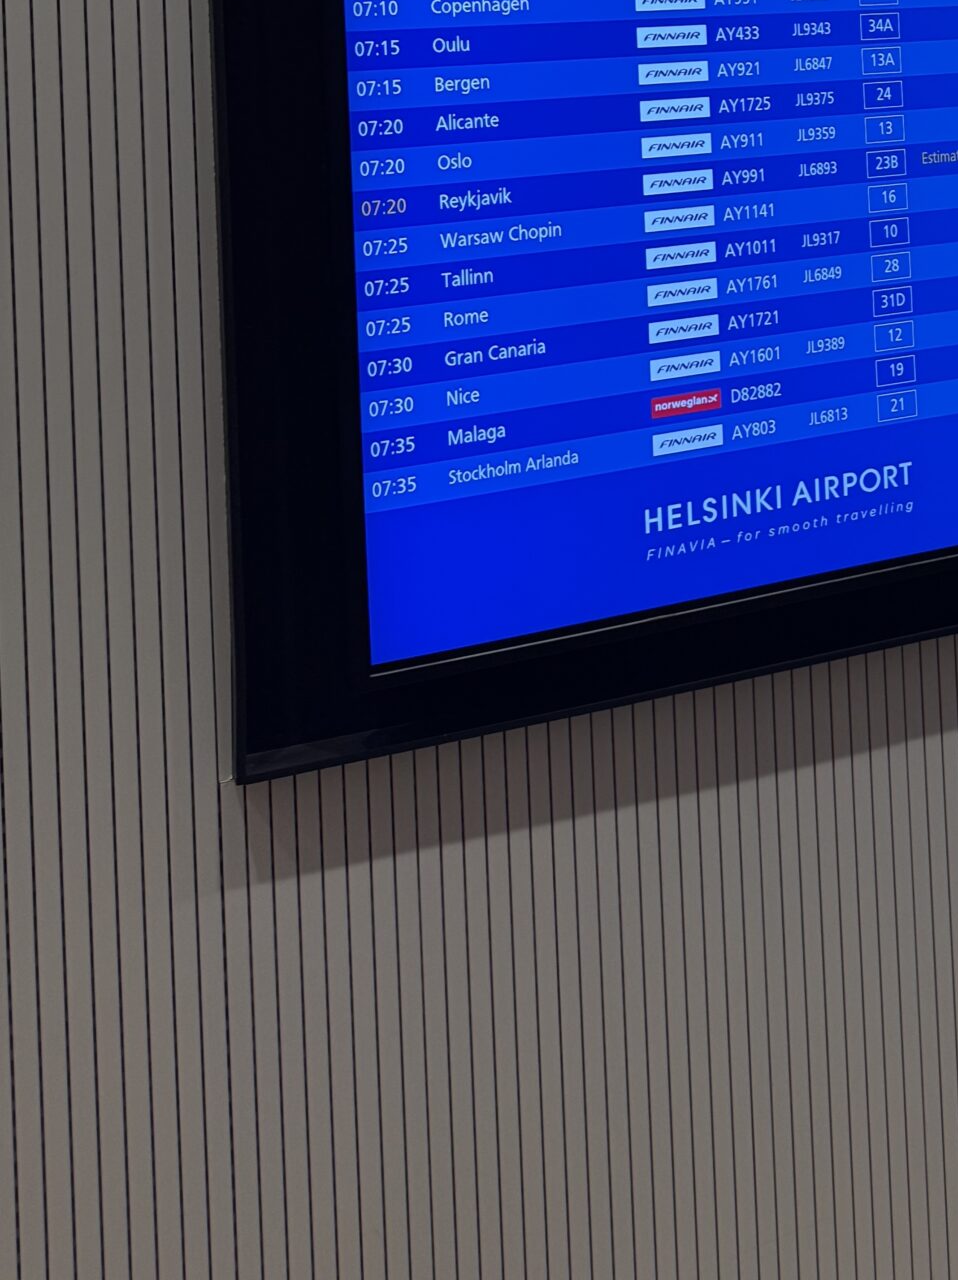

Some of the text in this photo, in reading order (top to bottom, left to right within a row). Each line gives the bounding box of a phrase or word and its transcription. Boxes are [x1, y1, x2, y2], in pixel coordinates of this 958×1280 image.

[361, 197, 407, 217] 07:20
[439, 186, 513, 212] Reykjavik
[648, 175, 708, 191] FINNAIR
[721, 167, 765, 186] AY991
[798, 160, 838, 177] JL6893
[875, 154, 899, 170] 23B
[367, 292, 906, 378] 07:30 Gran Canaria FINNAIR AY1721 31D
[372, 397, 904, 498] 07:35 Stockholm Arlanda FINNAIR AY803 JL6813 21
[644, 461, 912, 534] HELSINKI AIRPORT
[646, 537, 717, 561] FINAVIA
[736, 530, 760, 544] for
[768, 516, 828, 537] smooth
[836, 501, 914, 525] travelling
